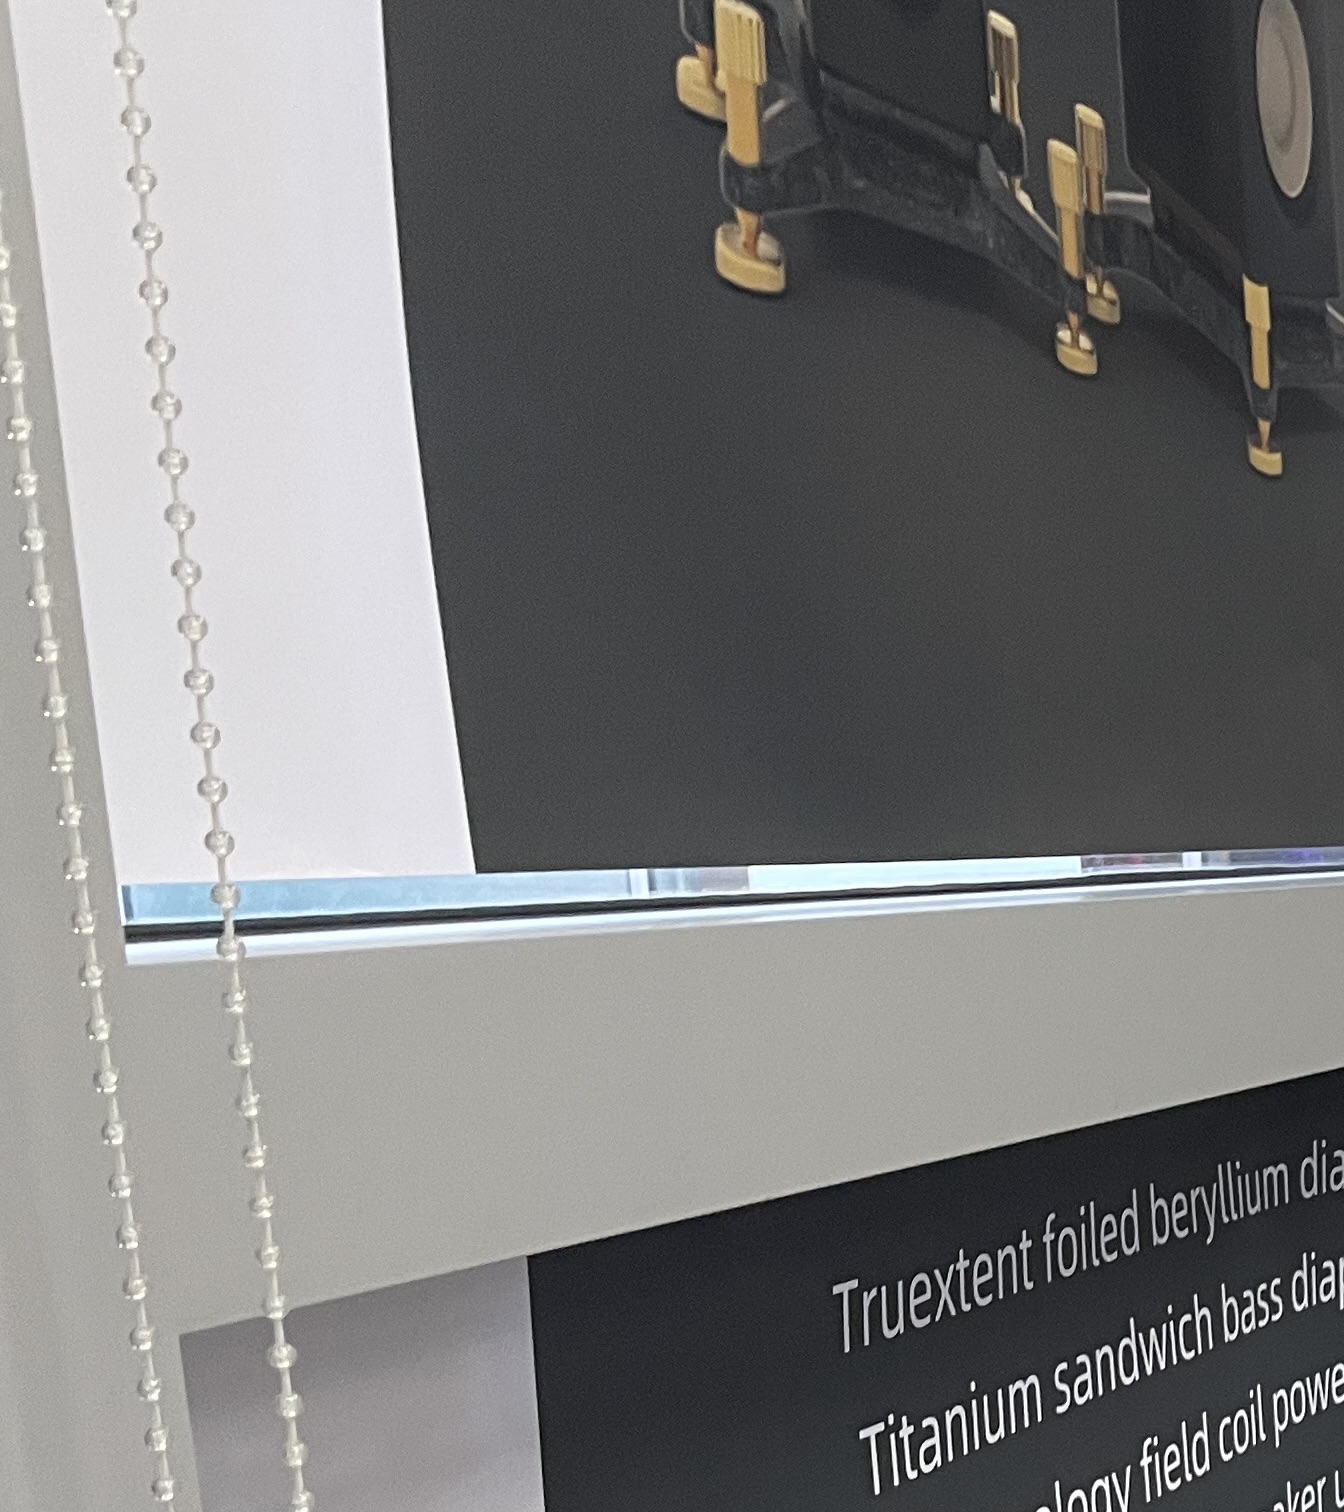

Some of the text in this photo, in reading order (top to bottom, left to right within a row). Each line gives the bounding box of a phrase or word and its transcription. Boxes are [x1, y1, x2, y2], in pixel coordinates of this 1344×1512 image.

[832, 1229, 1035, 1354] Truextent
[1042, 1188, 1140, 1283] foiled
[1149, 1161, 1290, 1246] beryllium
[859, 1376, 1043, 1496] Titanium
[1054, 1293, 1212, 1414] sandwich
[1221, 1276, 1284, 1344] bass
[1140, 1412, 1210, 1504] field
[1218, 1383, 1268, 1463] coil
